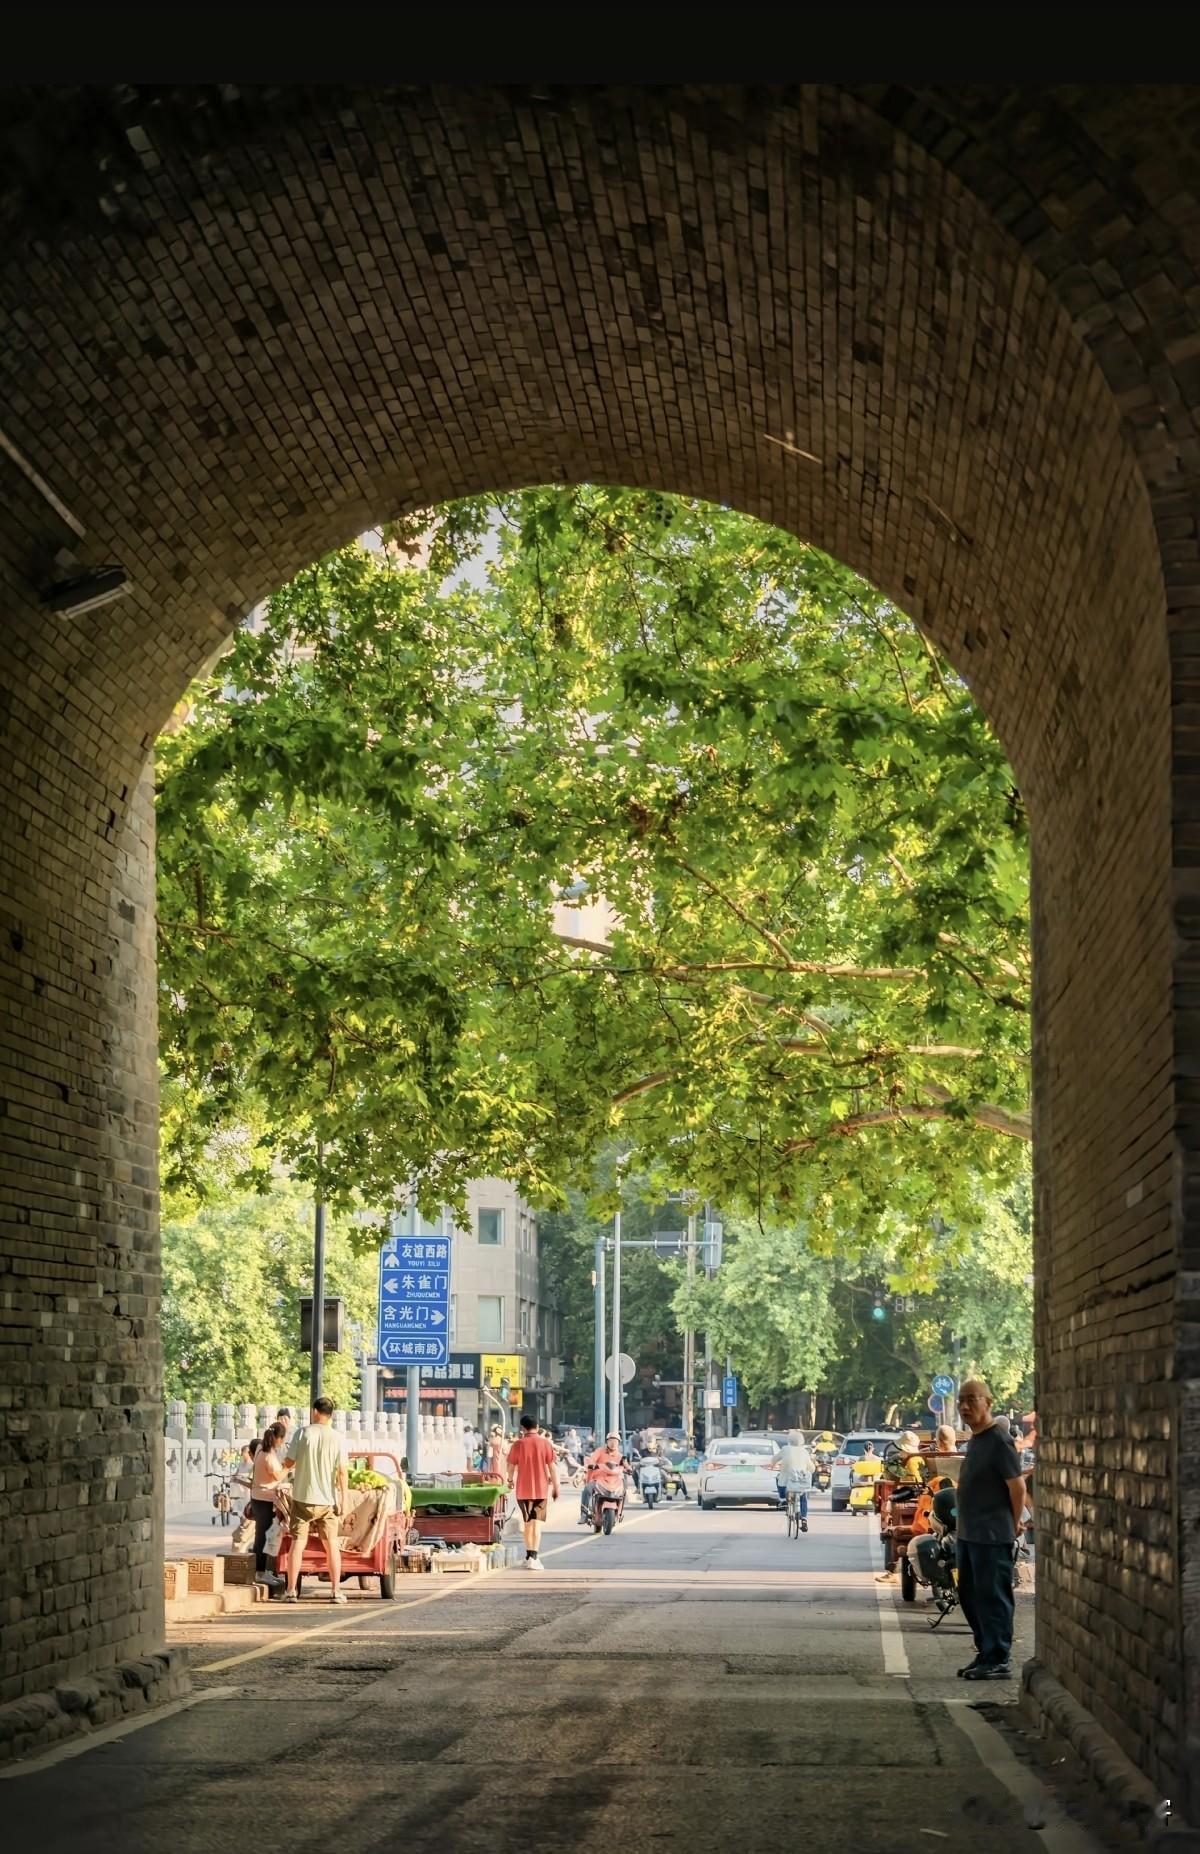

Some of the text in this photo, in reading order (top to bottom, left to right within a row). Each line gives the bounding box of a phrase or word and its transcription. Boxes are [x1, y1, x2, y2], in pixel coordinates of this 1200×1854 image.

[402, 1243, 447, 1258] 友谊西路
[402, 1274, 447, 1290] 朱雀门
[383, 1305, 429, 1320] 含光门
[389, 1342, 438, 1355] 环城南路
